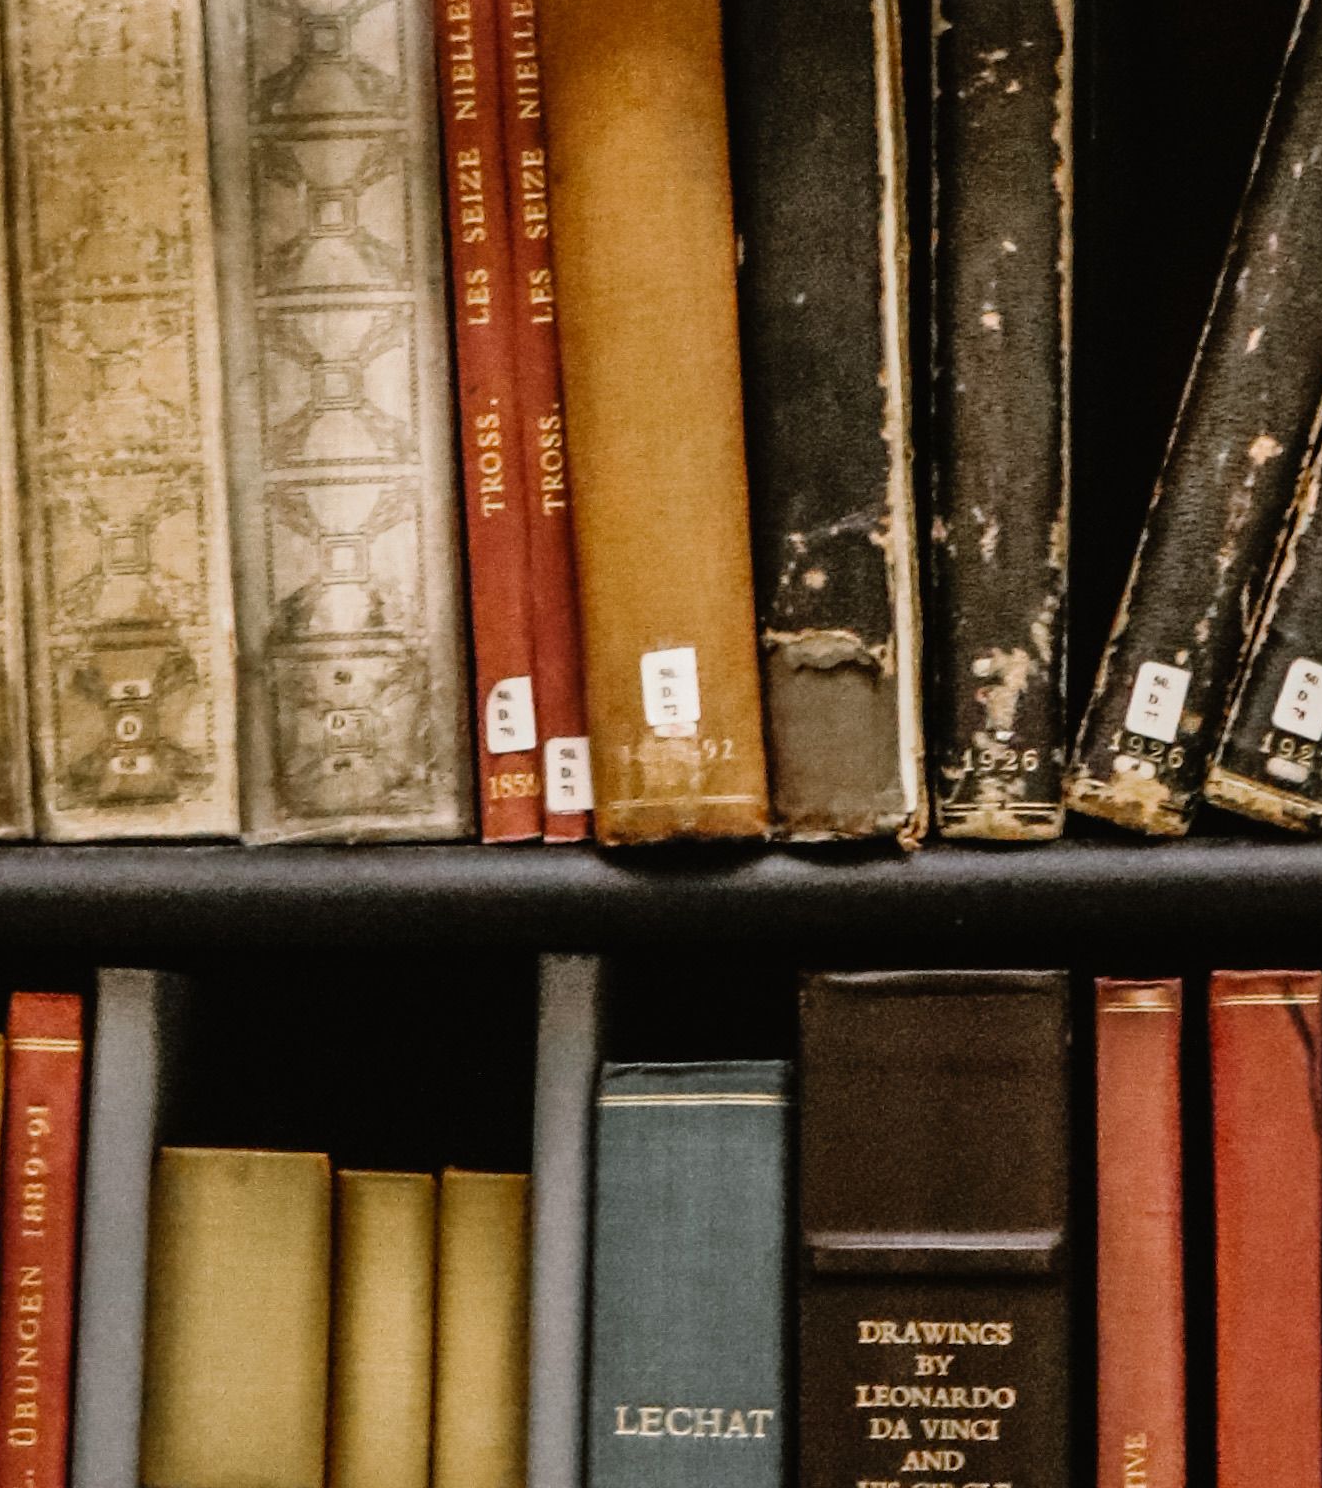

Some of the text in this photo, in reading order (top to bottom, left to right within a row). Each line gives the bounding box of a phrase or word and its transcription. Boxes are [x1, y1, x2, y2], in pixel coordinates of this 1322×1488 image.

[462, 145, 488, 248] SEIZE
[525, 145, 549, 242] SEIZE
[468, 268, 491, 326] LES
[482, 395, 504, 518] TROSS.
[543, 400, 564, 516] TROSS.
[960, 749, 1040, 772] 1926
[22, 1103, 50, 1238] 1889-91
[858, 1322, 1012, 1346] DRAWINGS
[9, 1265, 43, 1449] ÜBUNGEN
[915, 1354, 953, 1376] BY
[856, 1385, 1016, 1410] LEONARDO
[615, 1405, 774, 1438] LECHAT
[869, 1418, 999, 1442] DA VINCI
[901, 1450, 965, 1472] AND
